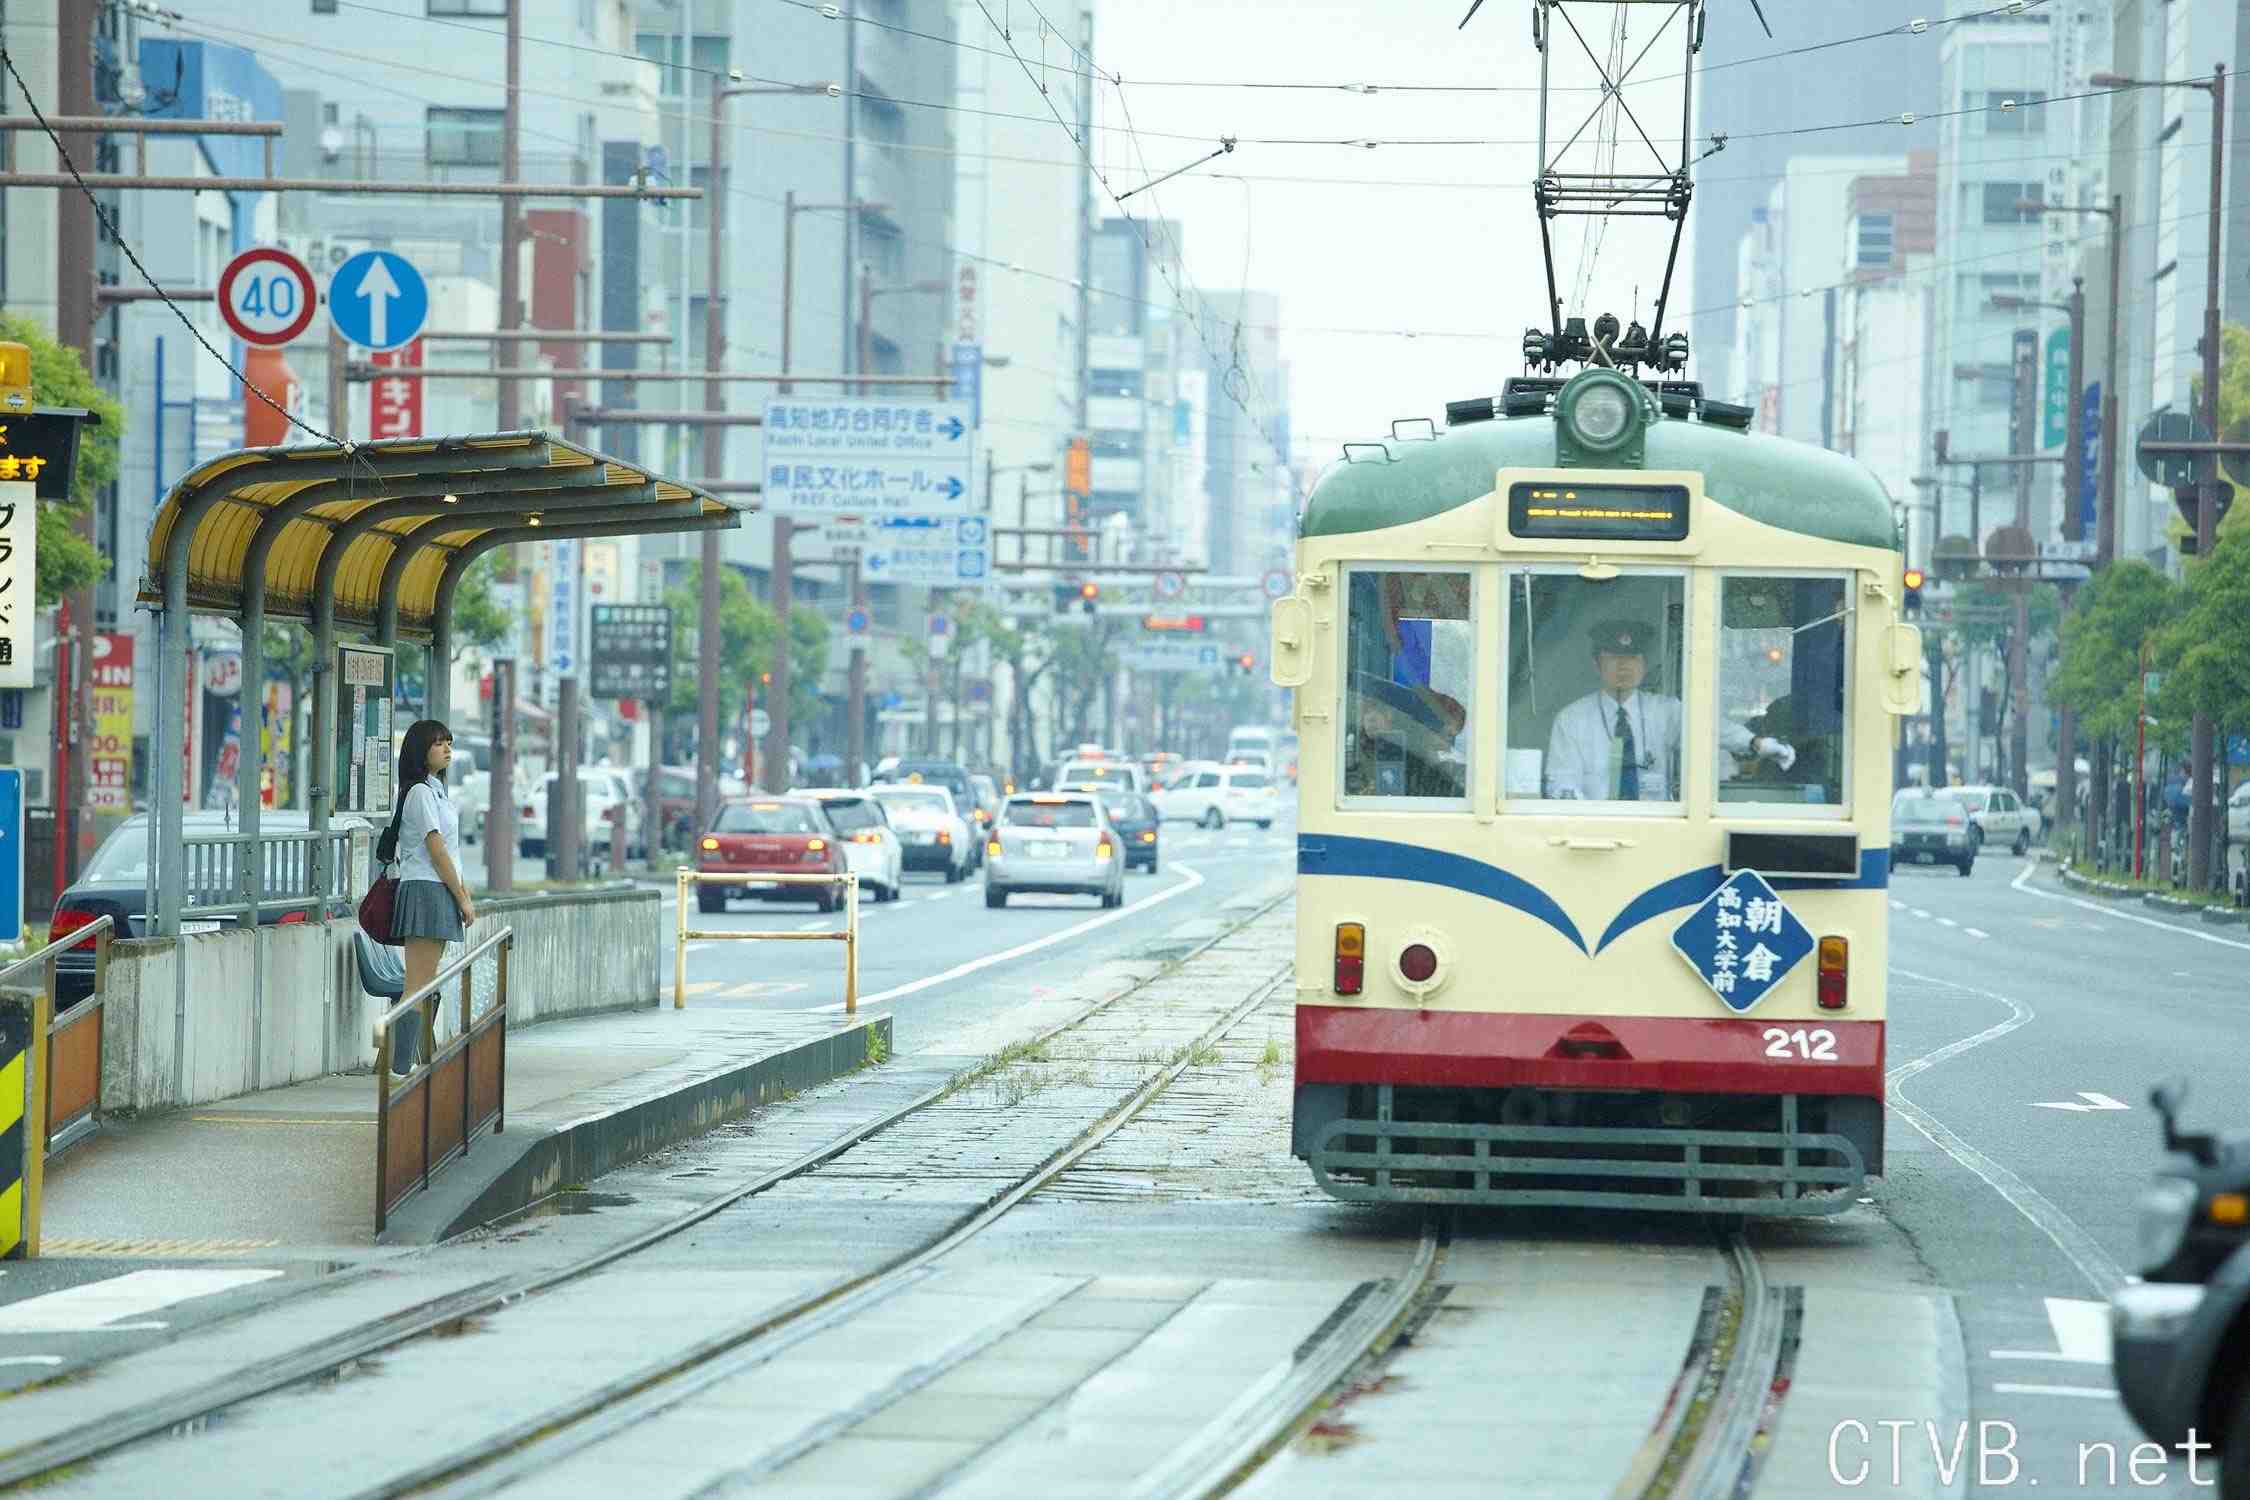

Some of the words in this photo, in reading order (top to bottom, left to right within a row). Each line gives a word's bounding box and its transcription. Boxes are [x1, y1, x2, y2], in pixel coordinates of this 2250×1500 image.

[240, 275, 294, 318] 40
[770, 465, 932, 491] 県民文化ホール
[1713, 886, 1742, 993] 高知大学前
[1742, 897, 1784, 982] 朝倉
[1763, 1028, 1839, 1060] 212
